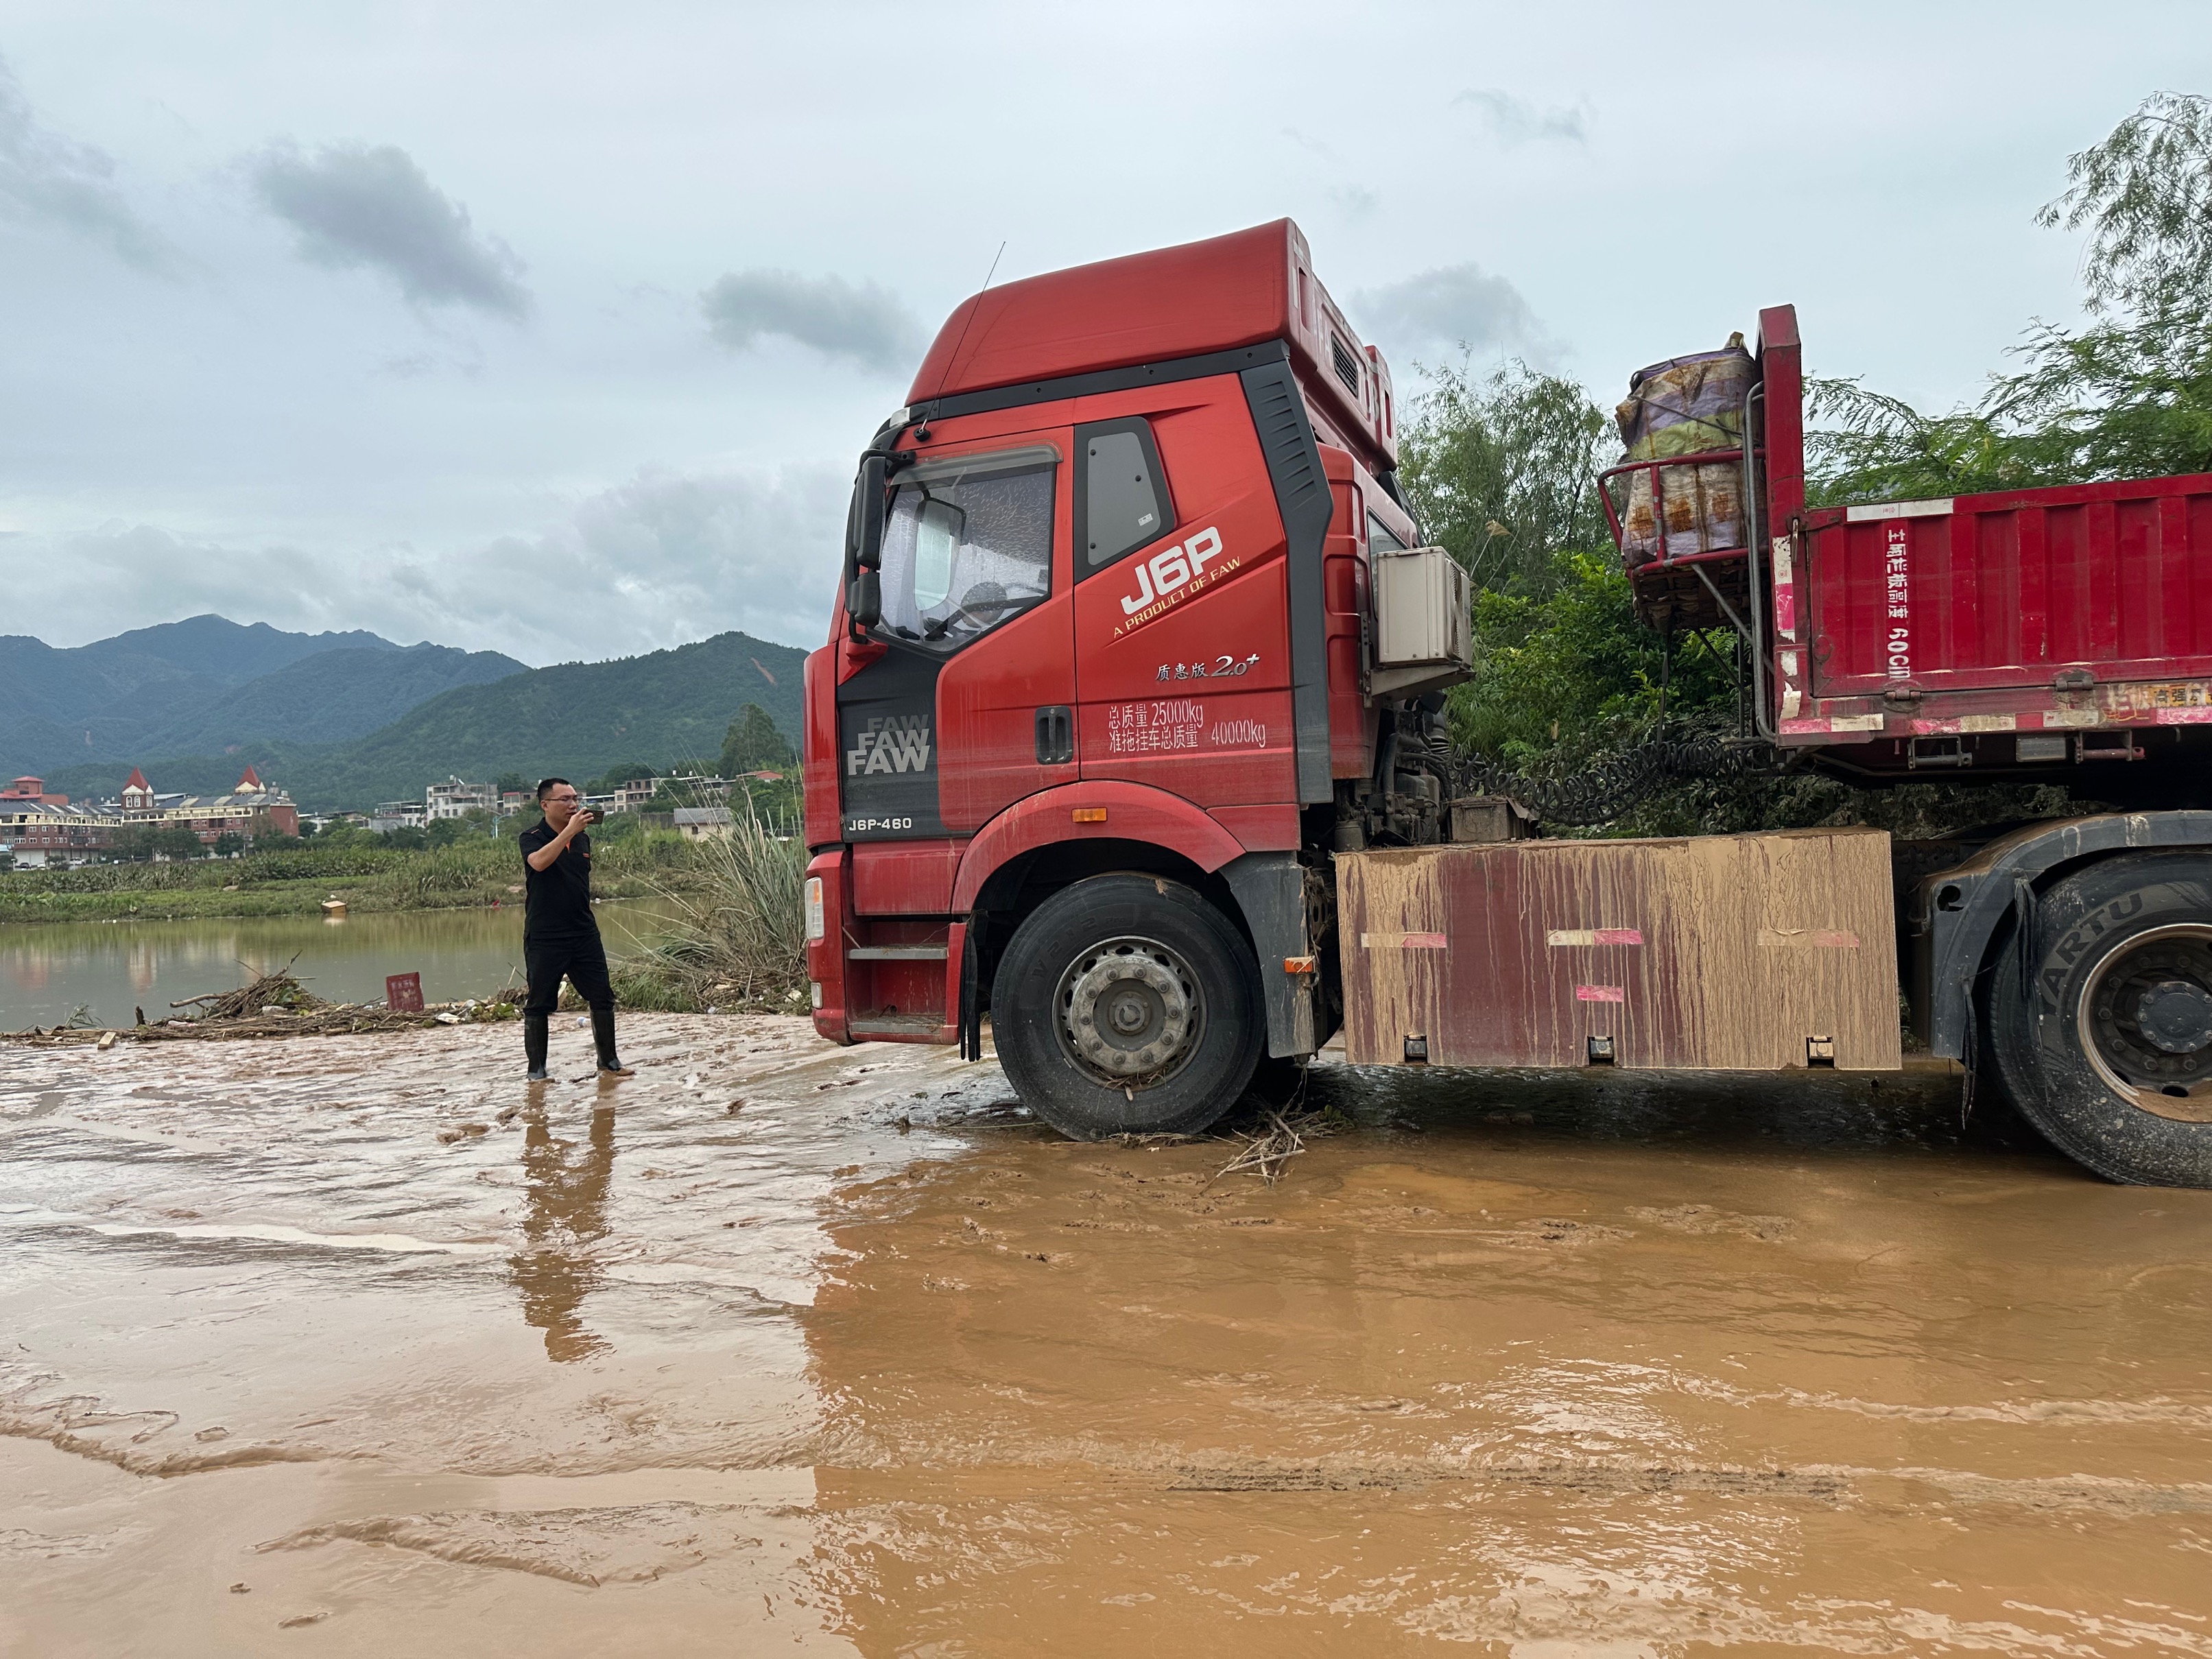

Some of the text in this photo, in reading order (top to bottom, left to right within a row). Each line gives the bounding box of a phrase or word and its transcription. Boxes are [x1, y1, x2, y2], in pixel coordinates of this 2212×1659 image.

[1121, 526, 1223, 615] J6P
[1886, 529, 1908, 619] 车厢栏板高度
[1114, 556, 1240, 638] A PRODUCT OF FAW
[1155, 663, 1209, 681] 质惠版
[867, 714, 929, 734] FAW
[1108, 700, 1204, 730] 总质量 25000kg
[858, 728, 930, 752] FAW
[1109, 719, 1267, 753] 准拖挂车总质量 40000kg
[847, 745, 931, 776] FAW
[849, 817, 912, 831] J6P-460
